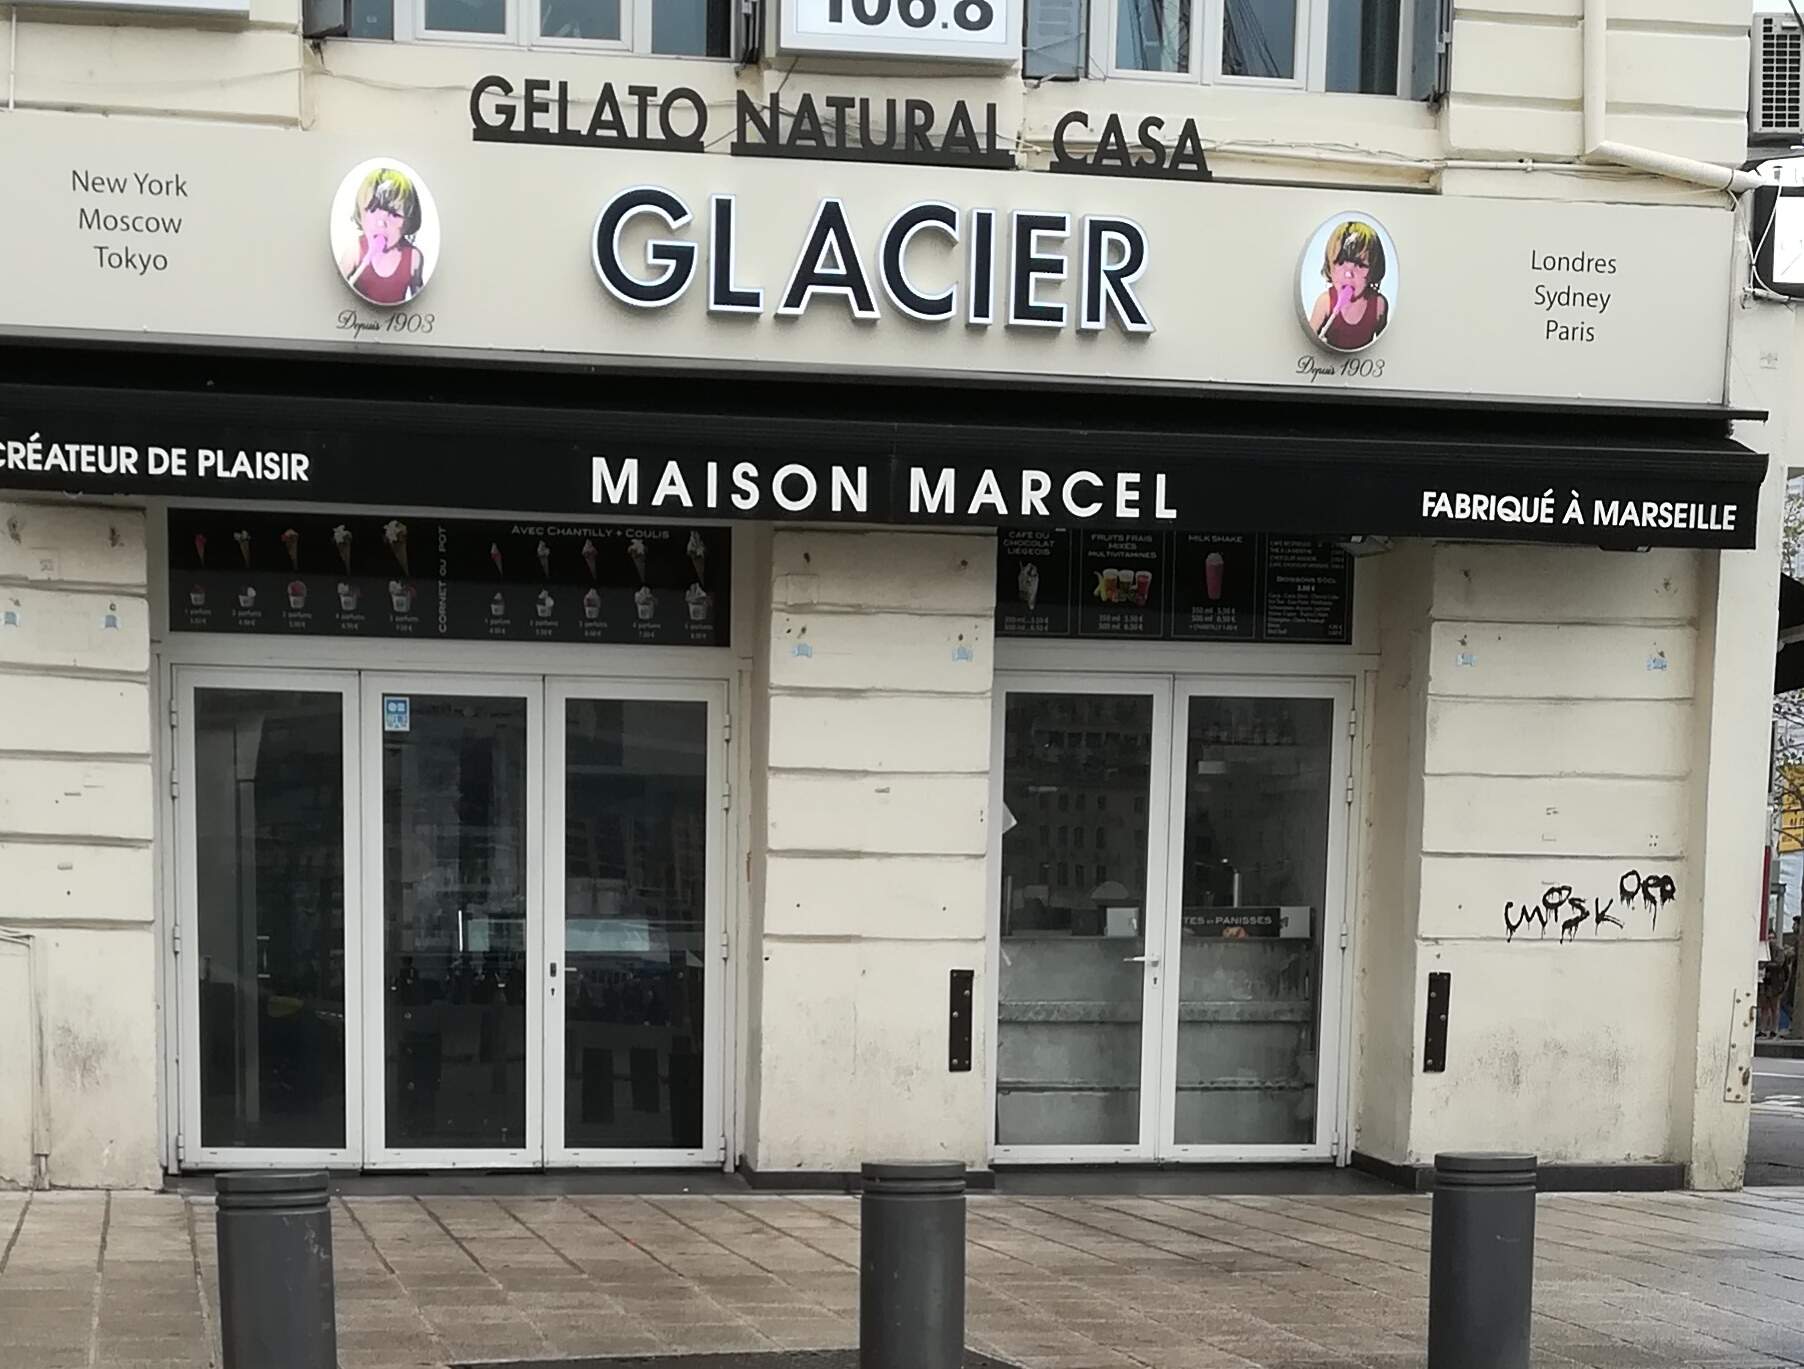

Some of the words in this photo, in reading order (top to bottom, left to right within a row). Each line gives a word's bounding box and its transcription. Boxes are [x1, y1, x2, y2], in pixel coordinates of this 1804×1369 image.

[470, 75, 708, 143] GELATO
[734, 89, 1012, 158] NATURAL
[1052, 110, 1212, 177] CASA
[71, 170, 128, 194] New
[134, 174, 188, 197] York
[79, 208, 183, 235] Moscow
[95, 246, 169, 274] Tokyo
[592, 185, 1156, 336] GLACIER
[1531, 250, 1618, 275] Londres
[1534, 284, 1611, 314] Sydney
[336, 309, 380, 339] Depuis
[385, 312, 436, 334] 1903
[1546, 320, 1595, 343] Paris
[1296, 355, 1335, 383] Depuis
[1340, 358, 1386, 378] 1903
[0, 432, 138, 475] RÉATEUR
[148, 446, 188, 477] DE
[198, 449, 310, 482] PLAISIR
[592, 456, 867, 514] MAISON
[909, 466, 1178, 520] MARCEL
[1422, 489, 1555, 526] FABRIQUÉ
[1562, 490, 1585, 526] À
[1593, 500, 1737, 531] MARSEILLE
[438, 526, 447, 552] POT
[547, 526, 613, 537] CHANTILLY
[438, 580, 447, 633] CORNET
[1215, 916, 1272, 925] PANISSES
